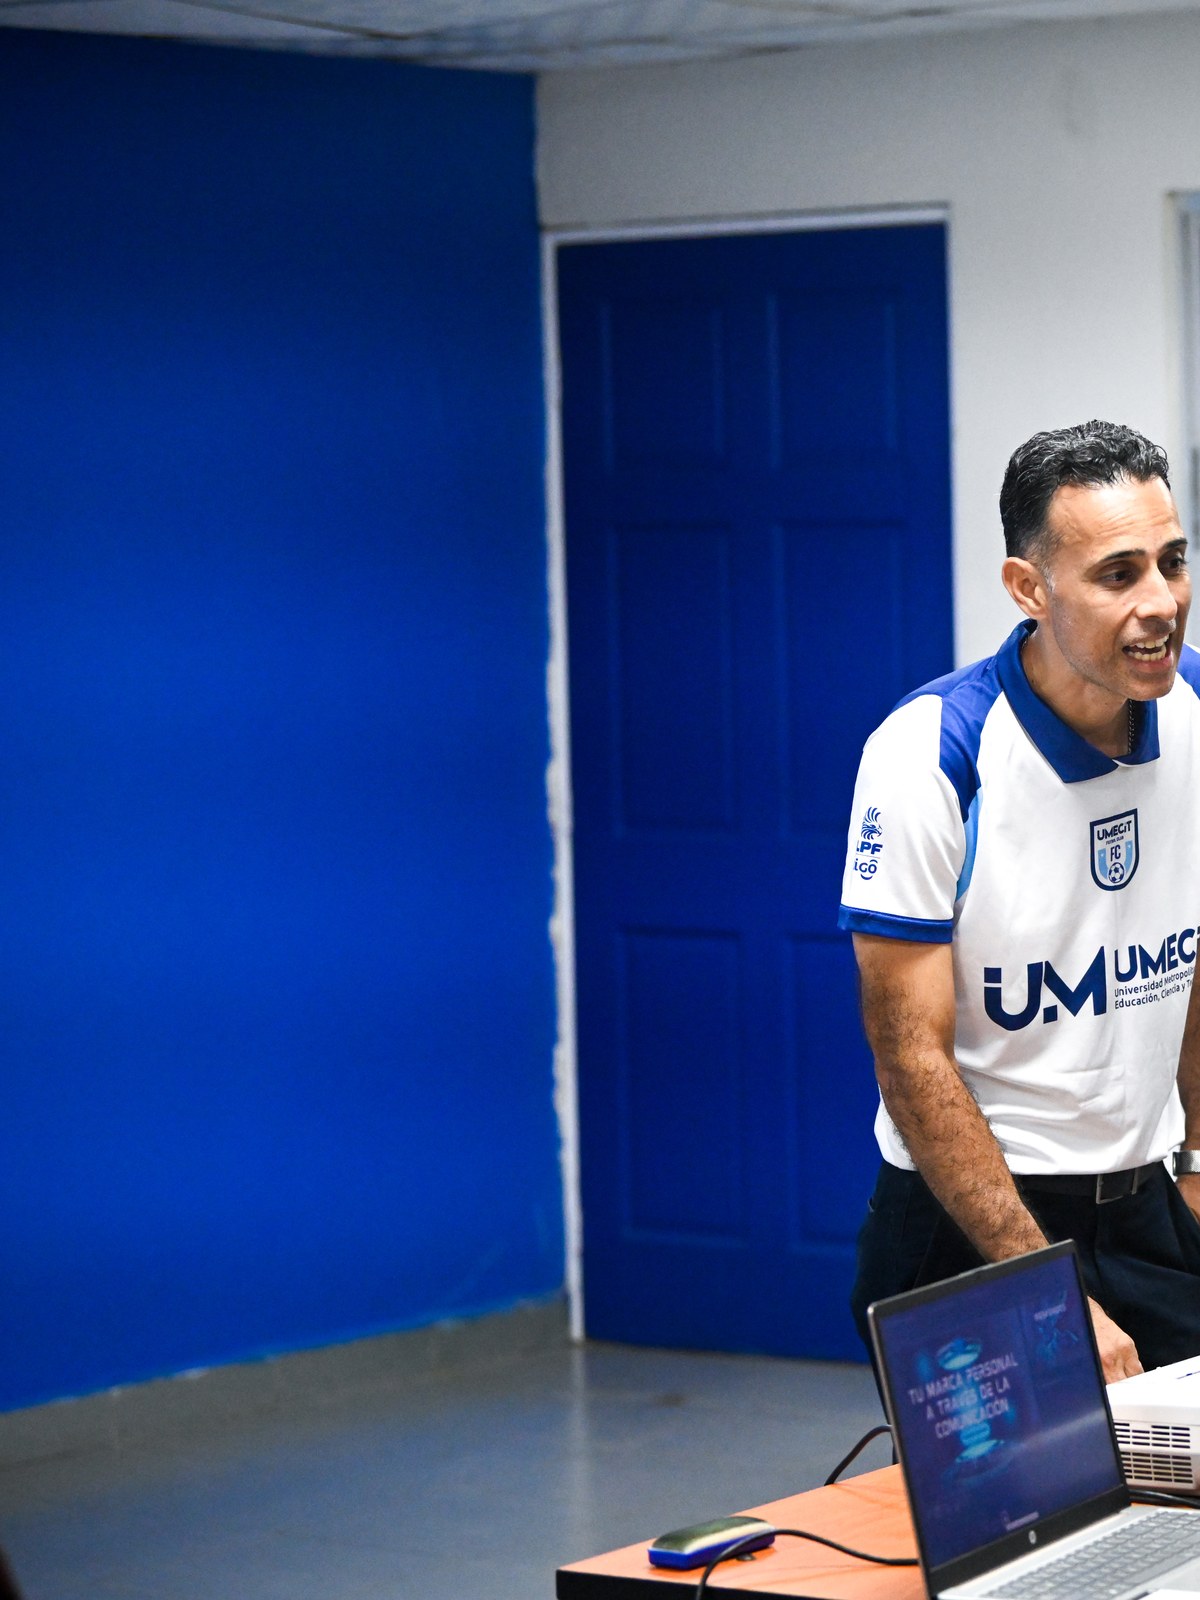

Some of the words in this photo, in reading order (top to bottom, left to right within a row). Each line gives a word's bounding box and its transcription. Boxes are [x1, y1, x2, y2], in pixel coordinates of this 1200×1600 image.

[1110, 844, 1121, 862] FC
[1114, 978, 1163, 997] Universidad
[1114, 992, 1160, 1010] Educación,
[1160, 983, 1181, 999] Ciencia
[1181, 982, 1187, 993] y
[908, 1387, 926, 1405] TU
[965, 1352, 1018, 1381] PERSONAL
[926, 1404, 935, 1420] A
[979, 1381, 994, 1399] DE
[995, 1375, 1011, 1394] LA
